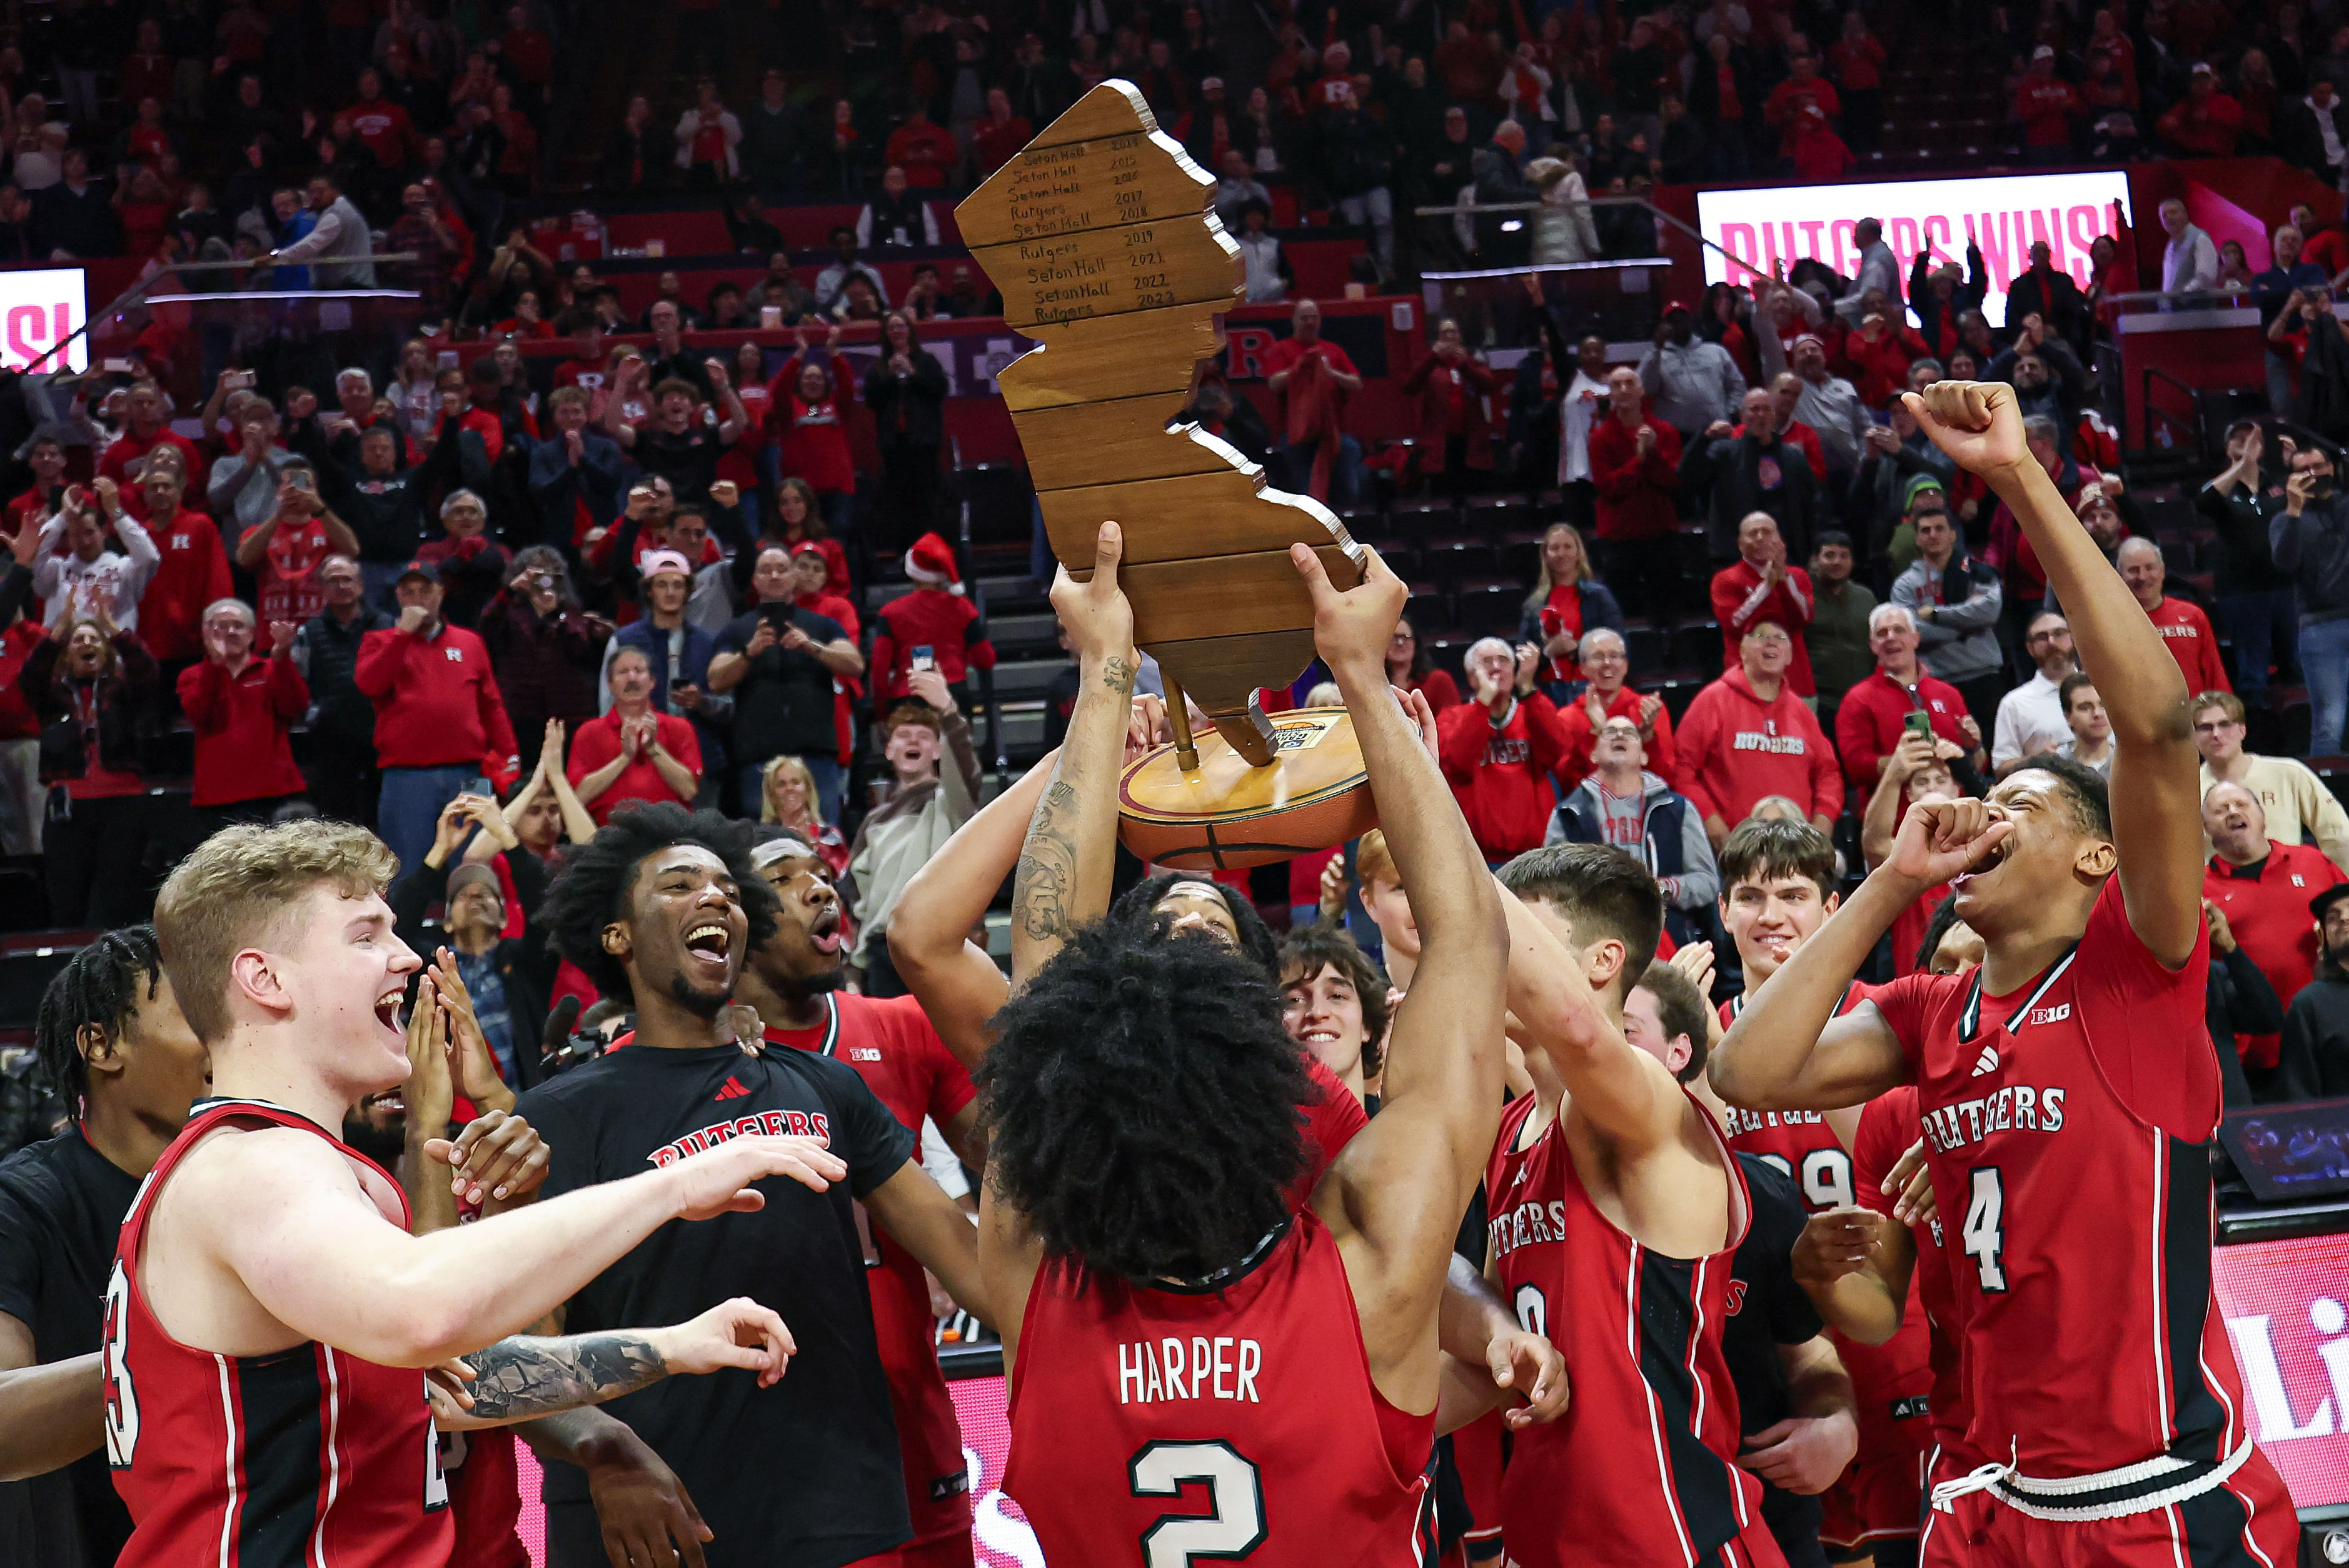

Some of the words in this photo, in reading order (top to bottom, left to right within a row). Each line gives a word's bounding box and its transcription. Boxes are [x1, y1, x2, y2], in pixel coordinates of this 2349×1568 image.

[1024, 154, 1058, 166] Seton
[1060, 148, 1085, 160] Hall
[1110, 155, 1137, 169] 2015
[1007, 187, 1050, 203] Seton
[1052, 182, 1081, 194] Hall
[1010, 205, 1066, 221] Rutgers
[1115, 189, 1144, 206] 2017
[1013, 222, 1057, 238] Seton
[1060, 211, 1092, 230] Hall
[1120, 206, 1148, 221] 2018
[1020, 243, 1079, 264] Rutgers
[1124, 229, 1154, 246] 2019
[1129, 251, 1166, 266] 2021
[1721, 214, 1952, 303] RUTGRS
[1134, 273, 1170, 290] 2022
[1035, 303, 1094, 329] Rutgers
[1137, 291, 1175, 307] 2023
[1920, 1085, 2066, 1155] RUTGERS
[1963, 1165, 2009, 1294] 4
[1118, 1336, 1262, 1404] HARPER
[1127, 1437, 1269, 1568] 2
